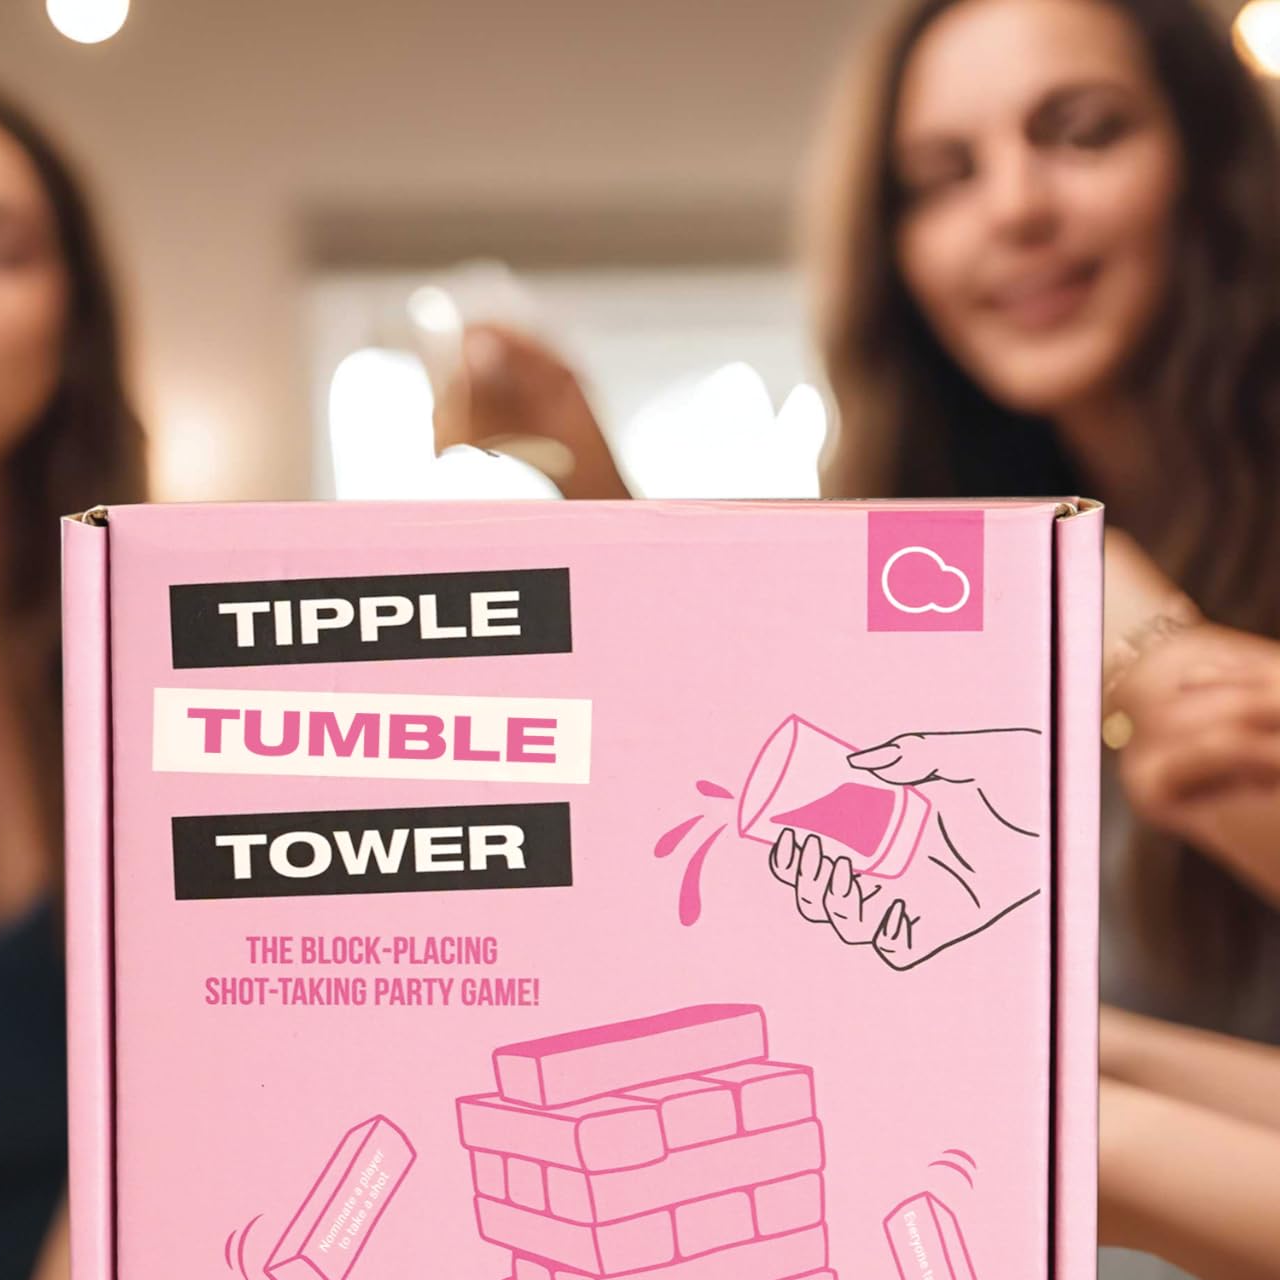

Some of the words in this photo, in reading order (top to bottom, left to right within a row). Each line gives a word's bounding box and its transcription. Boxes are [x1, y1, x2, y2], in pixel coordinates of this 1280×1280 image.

[219, 590, 521, 647] TIPPLE
[187, 708, 557, 764] TUMBLE
[215, 824, 527, 880] TOWER
[246, 936, 293, 965] THE
[301, 936, 498, 965] BLOCK-PLACING
[205, 977, 366, 1006] SHOT-TAKING
[374, 977, 454, 1006] PARTY
[461, 977, 540, 1006] GAME!
[356, 1188, 363, 1197] a
[359, 1149, 385, 1189] player
[319, 1197, 357, 1253] Nominate
[338, 1236, 352, 1250] to
[347, 1209, 367, 1237] take
[364, 1200, 373, 1209] a
[370, 1171, 390, 1199] shot
[903, 1210, 929, 1270] Everyone
